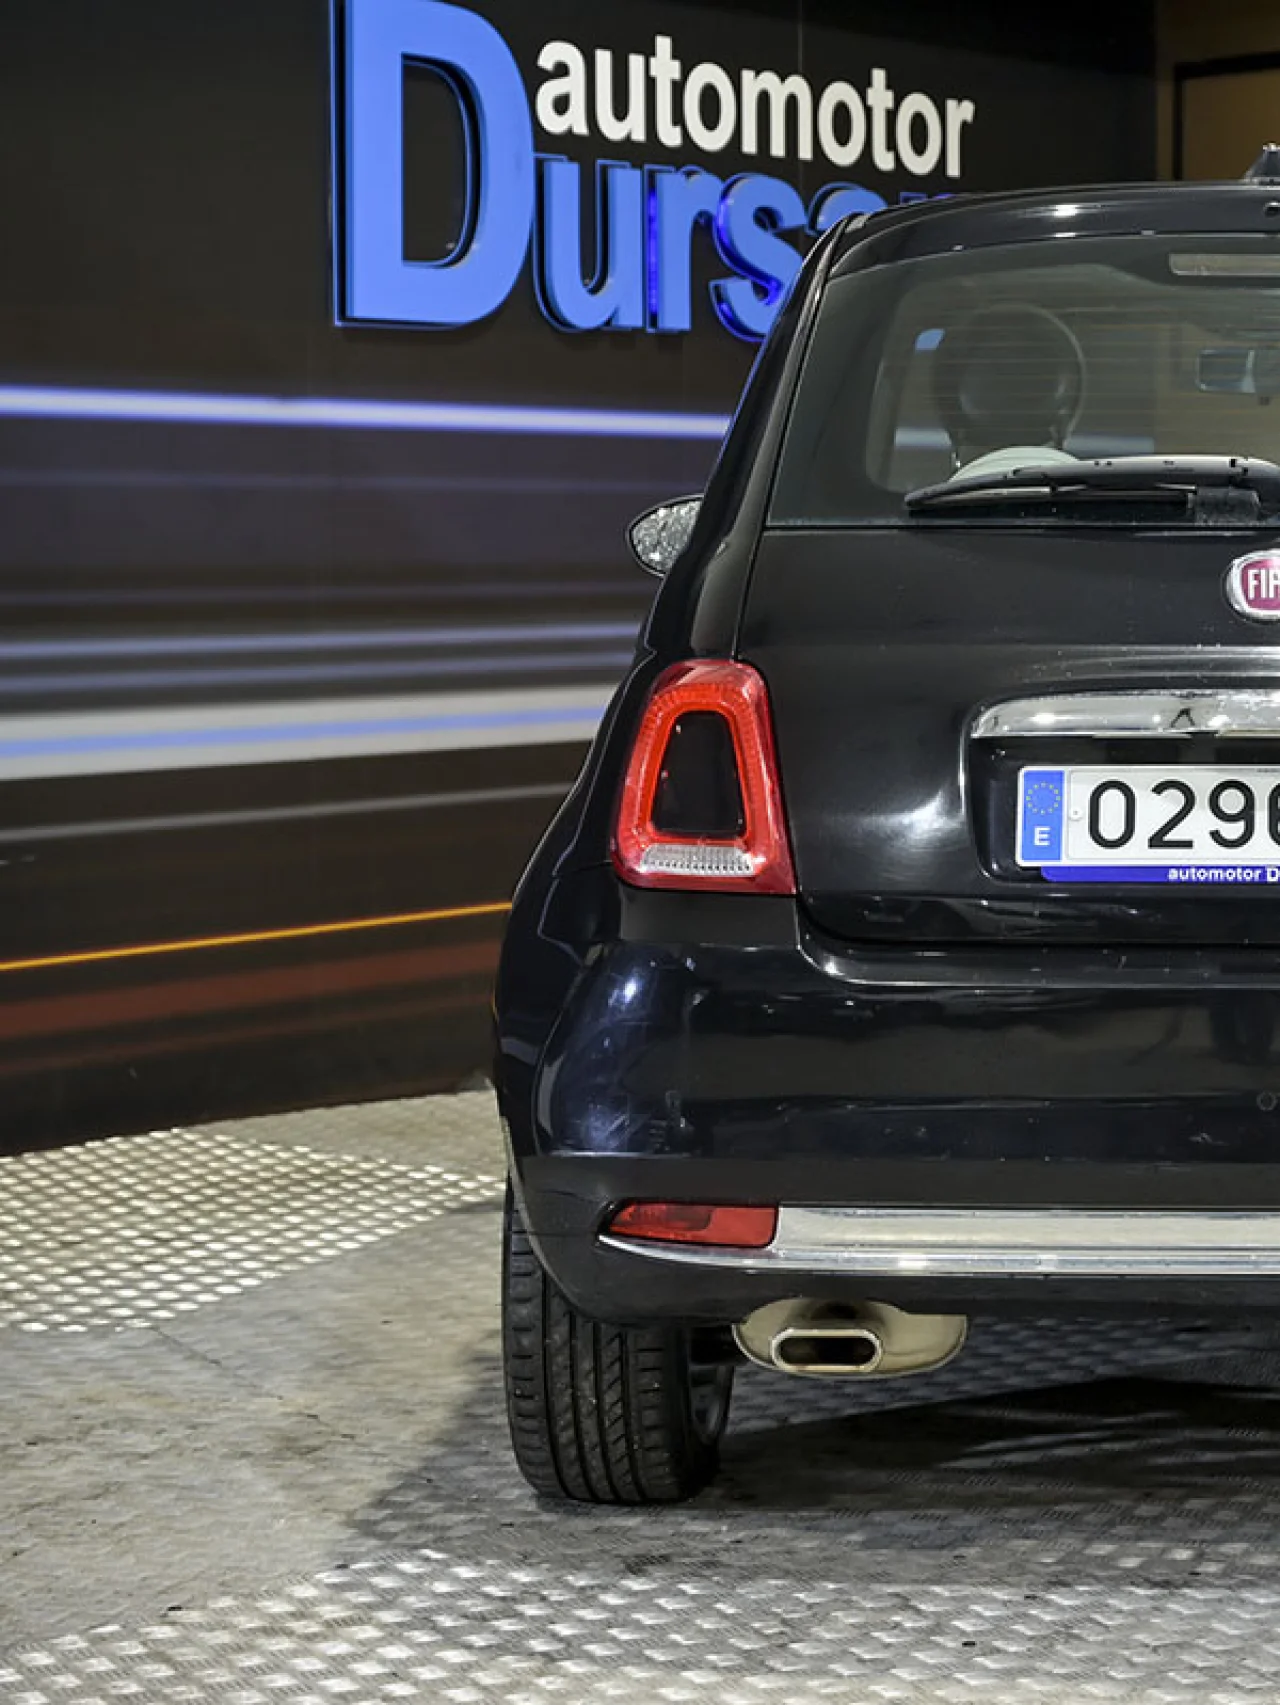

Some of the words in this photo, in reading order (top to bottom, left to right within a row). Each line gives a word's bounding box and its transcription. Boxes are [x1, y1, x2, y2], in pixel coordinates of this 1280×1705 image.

[535, 35, 975, 178] automotor
[332, 0, 952, 343] Durs
[1034, 826, 1051, 846] E
[1168, 867, 1262, 880] automotor
